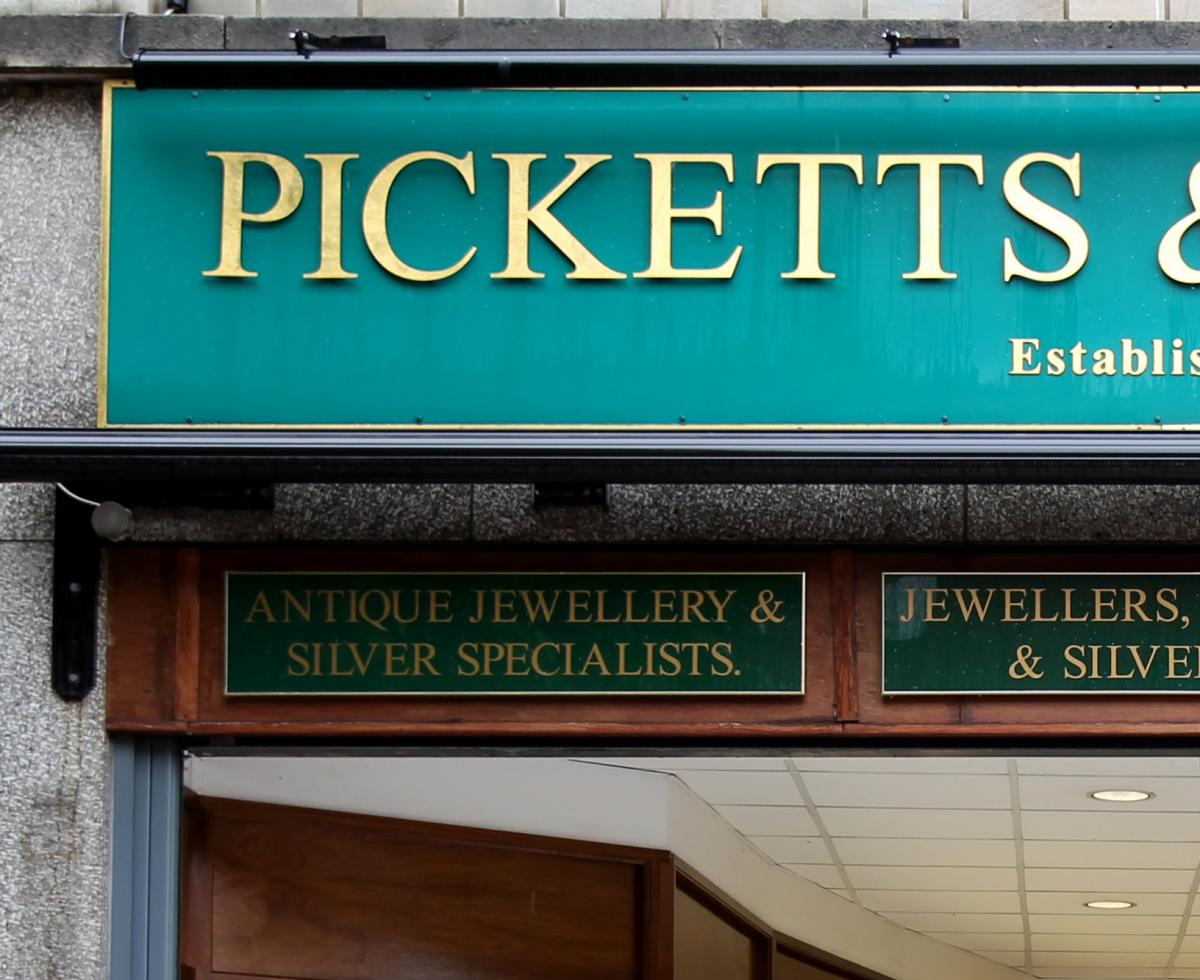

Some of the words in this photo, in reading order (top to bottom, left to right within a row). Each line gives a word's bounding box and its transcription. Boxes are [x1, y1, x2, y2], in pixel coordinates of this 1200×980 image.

[203, 150, 1091, 286] PICKETTS
[244, 588, 453, 630] ANTIQUE
[468, 588, 737, 625] JEWELLERY
[750, 588, 785, 625] &
[899, 587, 1192, 629] JEWELLERS,
[287, 641, 441, 677] SILVER
[457, 641, 741, 677] SPECIALISTS.
[1008, 644, 1045, 680] &
